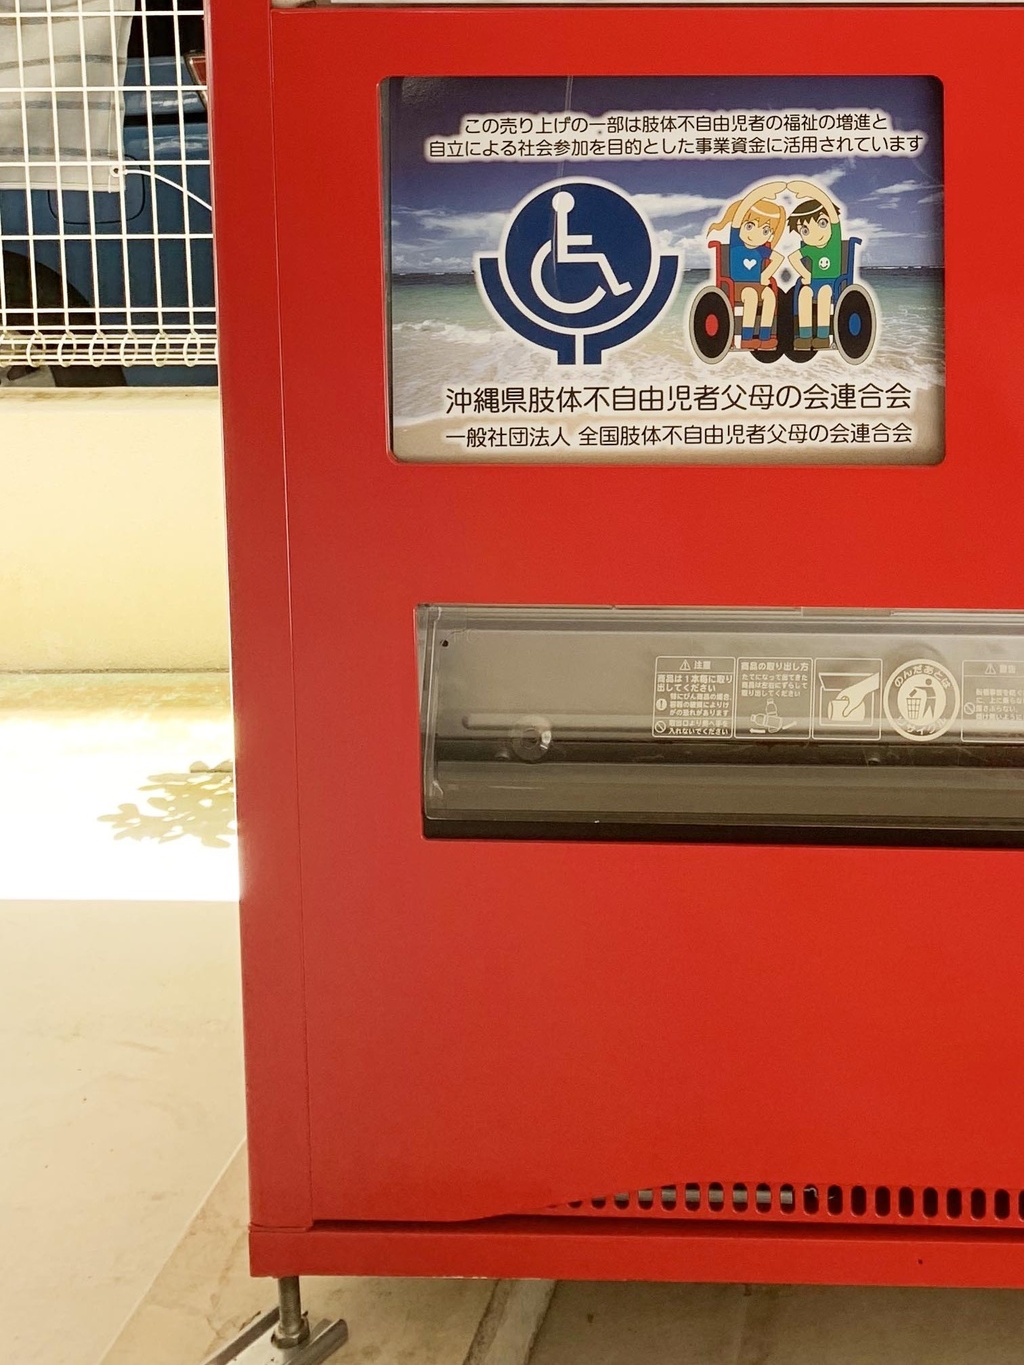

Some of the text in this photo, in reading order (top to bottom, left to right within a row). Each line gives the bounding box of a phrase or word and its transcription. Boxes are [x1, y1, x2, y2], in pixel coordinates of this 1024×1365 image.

[464, 112, 888, 136] この売り上げの一部は肢体不自由児者の福祉の増進と
[428, 135, 924, 158] 自立による社会参加を目的とした事業資金に活用されています
[445, 383, 912, 415] 沖縄県肢体不自由児者父母の会連合会
[445, 424, 913, 448] 一般社団法人 全国肢体不自由児者父母の会連合会
[894, 664, 951, 689] のんだあとは
